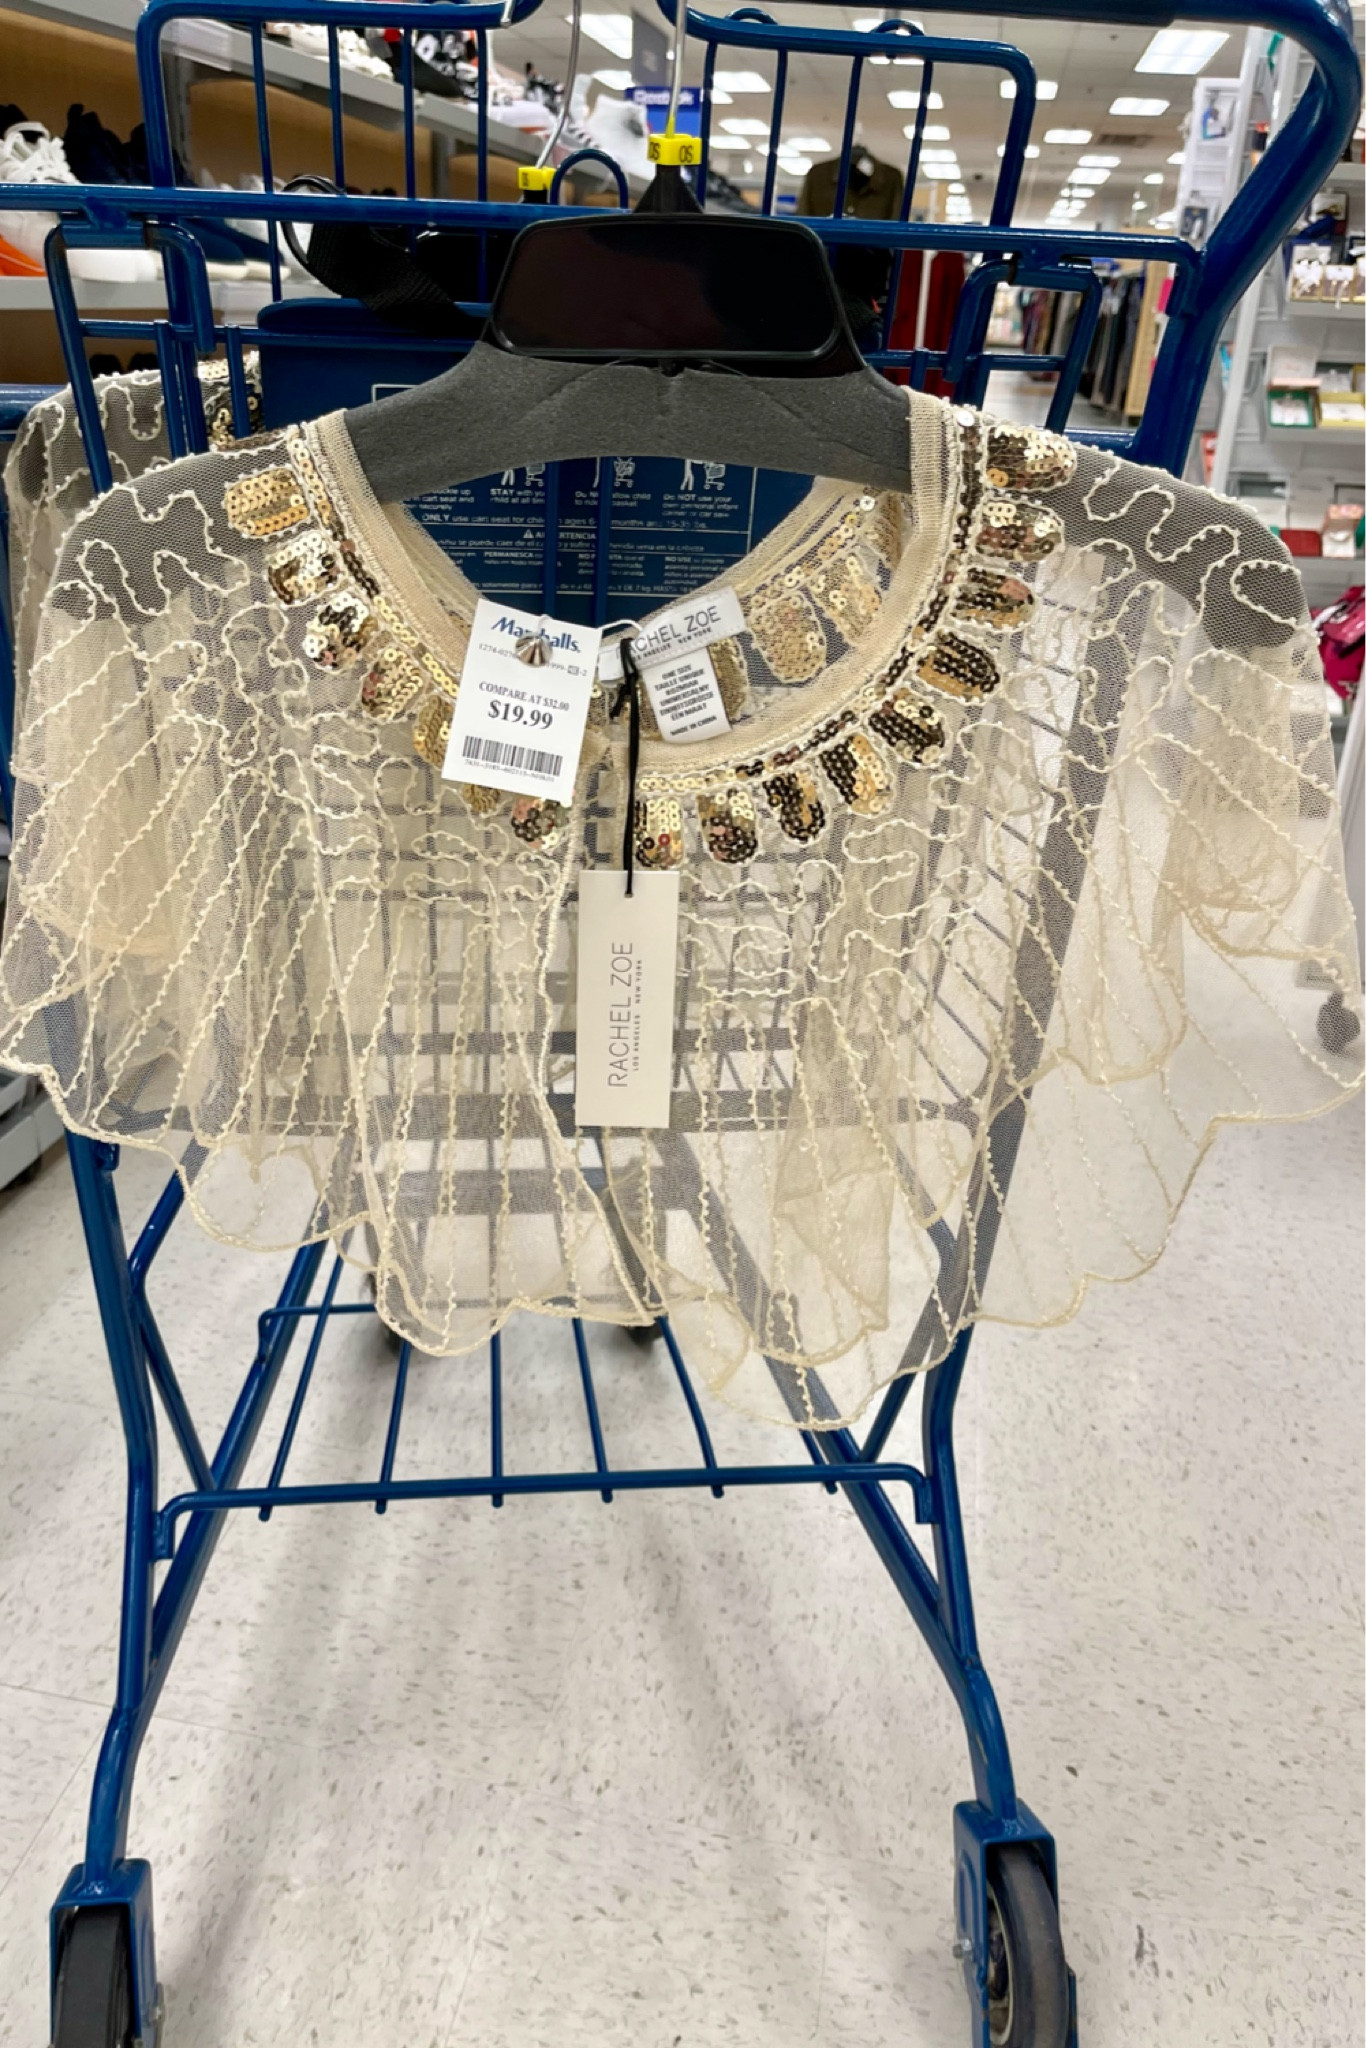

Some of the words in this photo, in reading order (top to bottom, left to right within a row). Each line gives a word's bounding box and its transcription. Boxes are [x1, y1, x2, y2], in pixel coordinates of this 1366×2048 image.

[679, 145, 694, 163] OS
[489, 488, 515, 496] STAY
[678, 493, 697, 502] NOT
[422, 513, 450, 522] ONLY
[684, 605, 722, 633] ZOE
[478, 681, 528, 702] COMPARE
[528, 694, 542, 705] AT
[488, 699, 554, 730] $19.99
[611, 943, 633, 987] ZOE
[608, 997, 631, 1087] RACHEL
[633, 1015, 641, 1053] ANGELES
[632, 1056, 640, 1072] LOS
